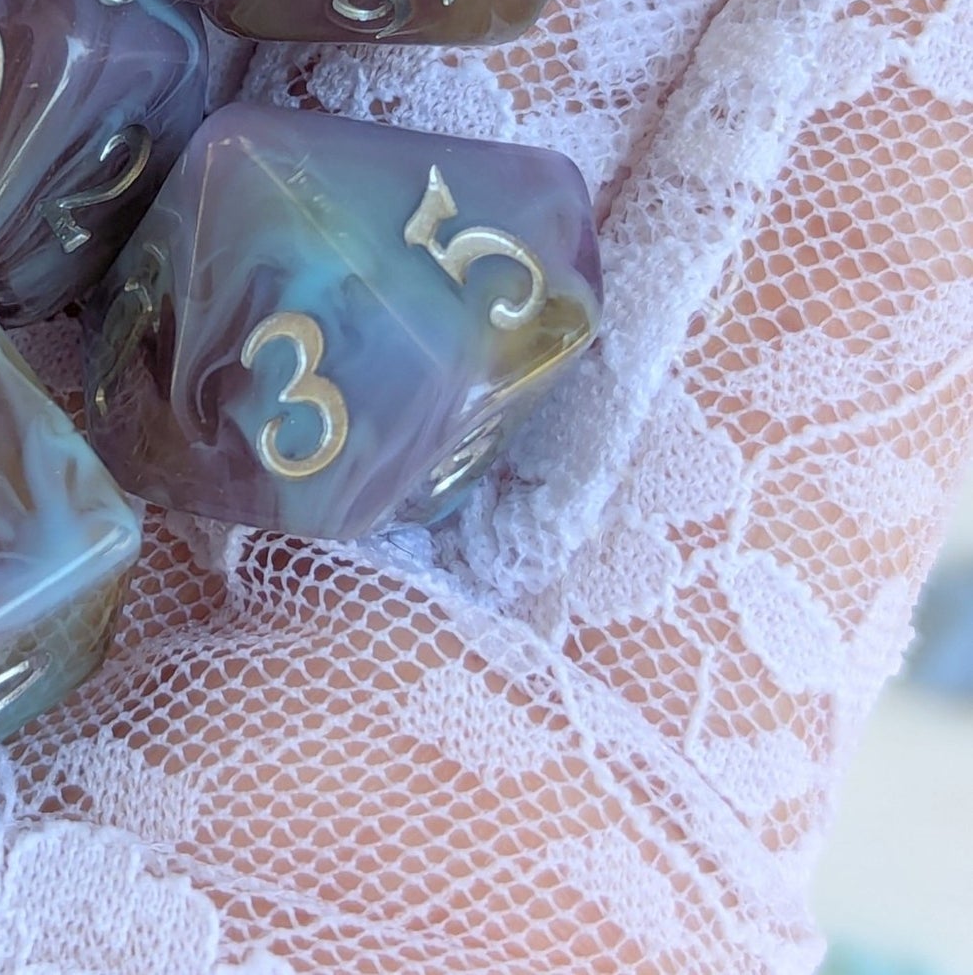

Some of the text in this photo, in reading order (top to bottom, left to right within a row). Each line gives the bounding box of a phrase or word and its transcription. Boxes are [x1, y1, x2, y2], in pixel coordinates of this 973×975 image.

[34, 123, 153, 254] 2
[404, 164, 546, 331] 5
[241, 311, 349, 480] 3
